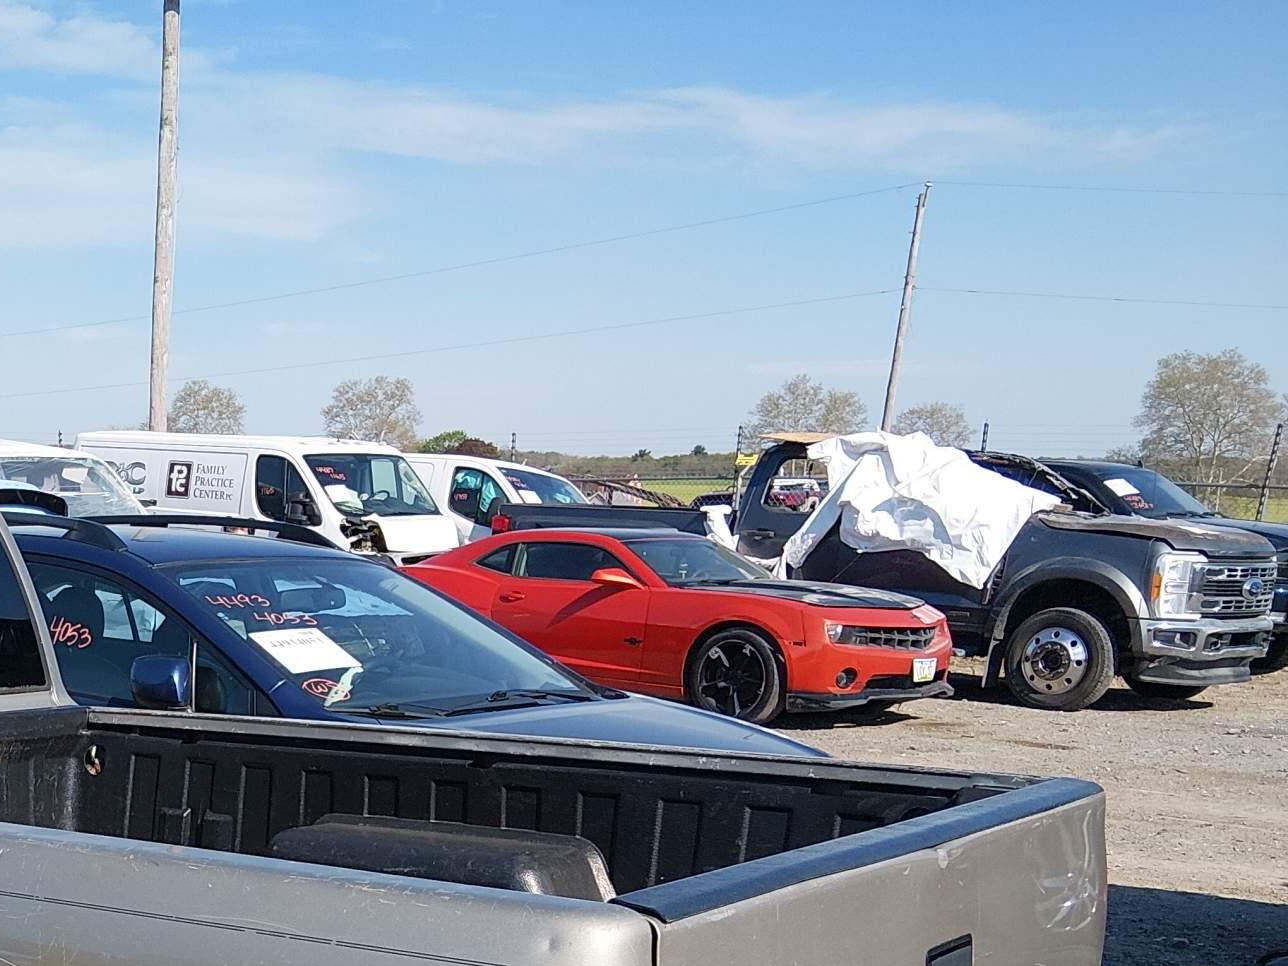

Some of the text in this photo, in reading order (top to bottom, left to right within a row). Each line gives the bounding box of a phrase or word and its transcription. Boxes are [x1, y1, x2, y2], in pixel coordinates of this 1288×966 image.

[196, 463, 227, 475] FAMILY
[194, 475, 235, 489] PRACTICE
[193, 487, 225, 501] CENTER
[205, 593, 270, 609] 4493
[253, 612, 318, 626] 4053
[50, 615, 92, 649] 4053
